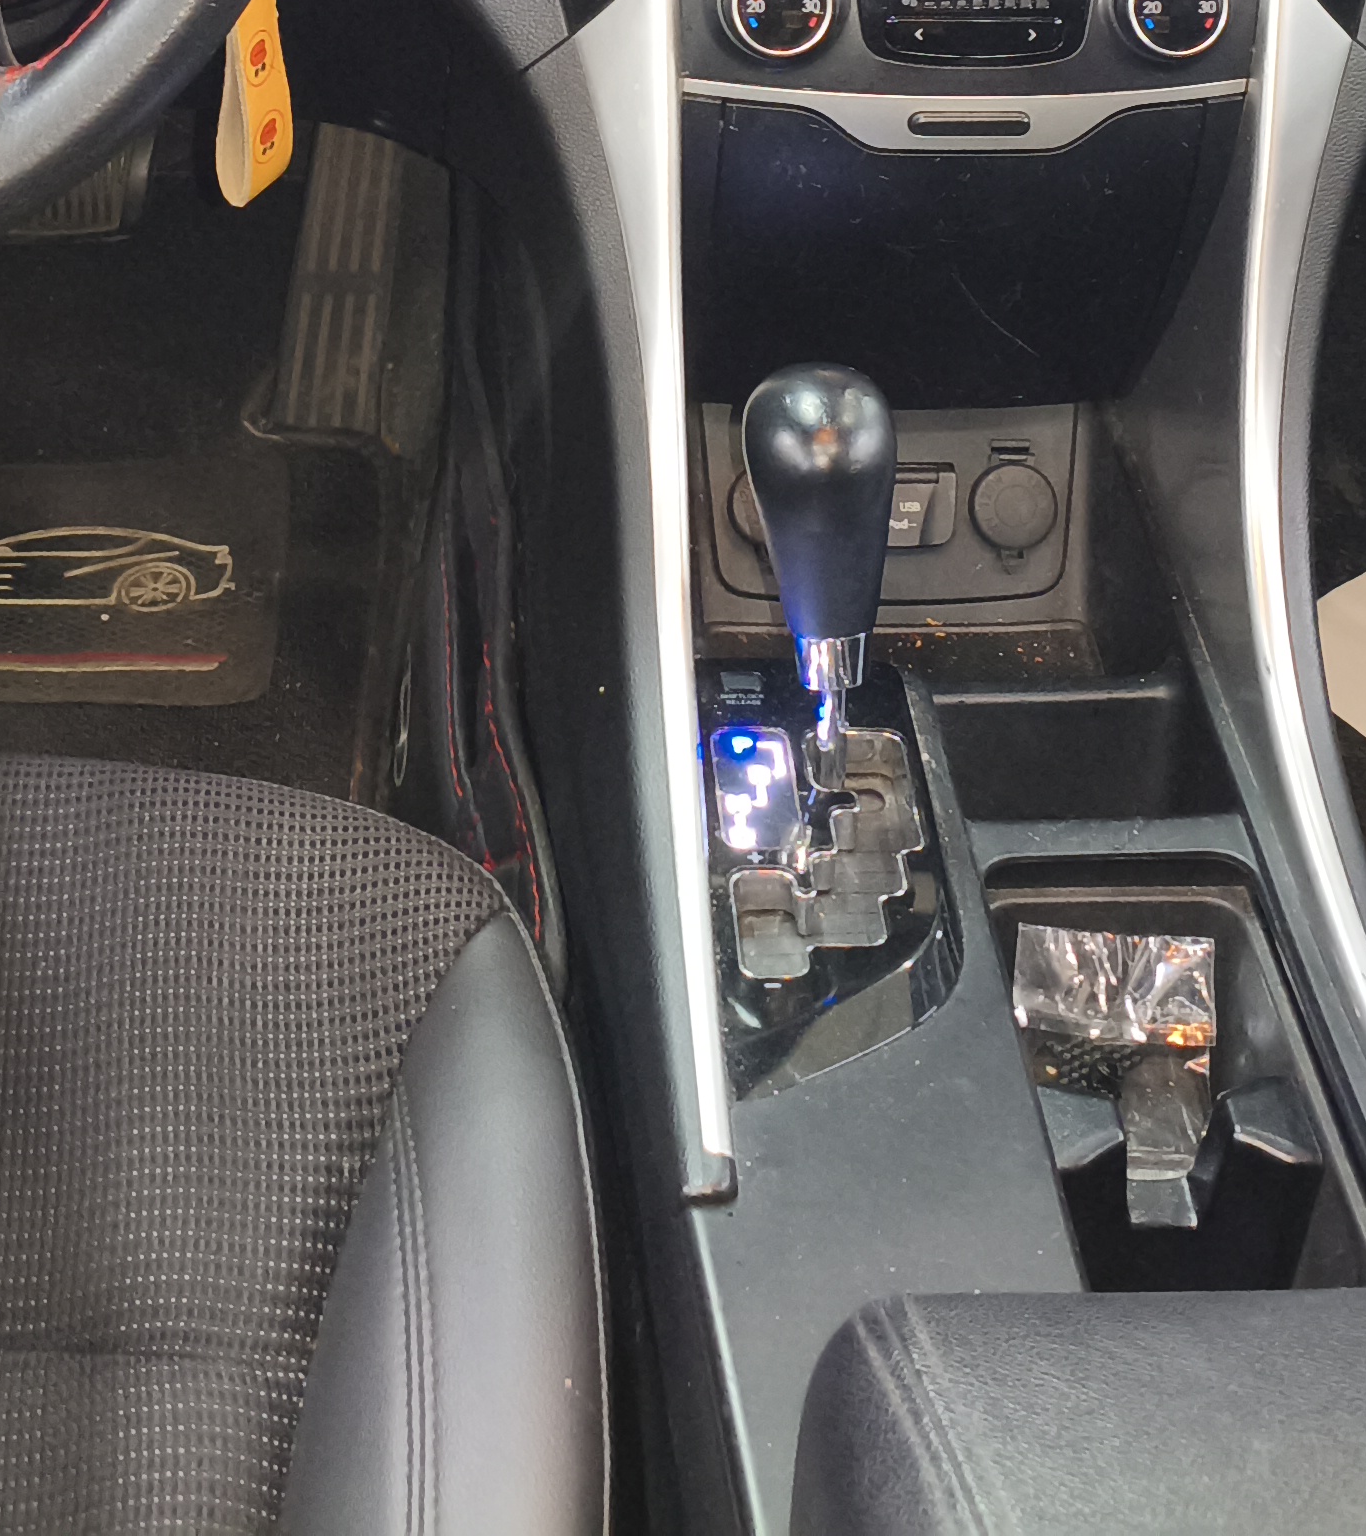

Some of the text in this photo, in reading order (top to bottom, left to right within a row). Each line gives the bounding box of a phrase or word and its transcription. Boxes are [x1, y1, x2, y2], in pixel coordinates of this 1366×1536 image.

[746, 0, 766, 13] 20
[801, 0, 821, 13] 30
[1142, 1, 1163, 14] 20
[1197, 0, 1217, 14] 30
[899, 501, 922, 512] USB
